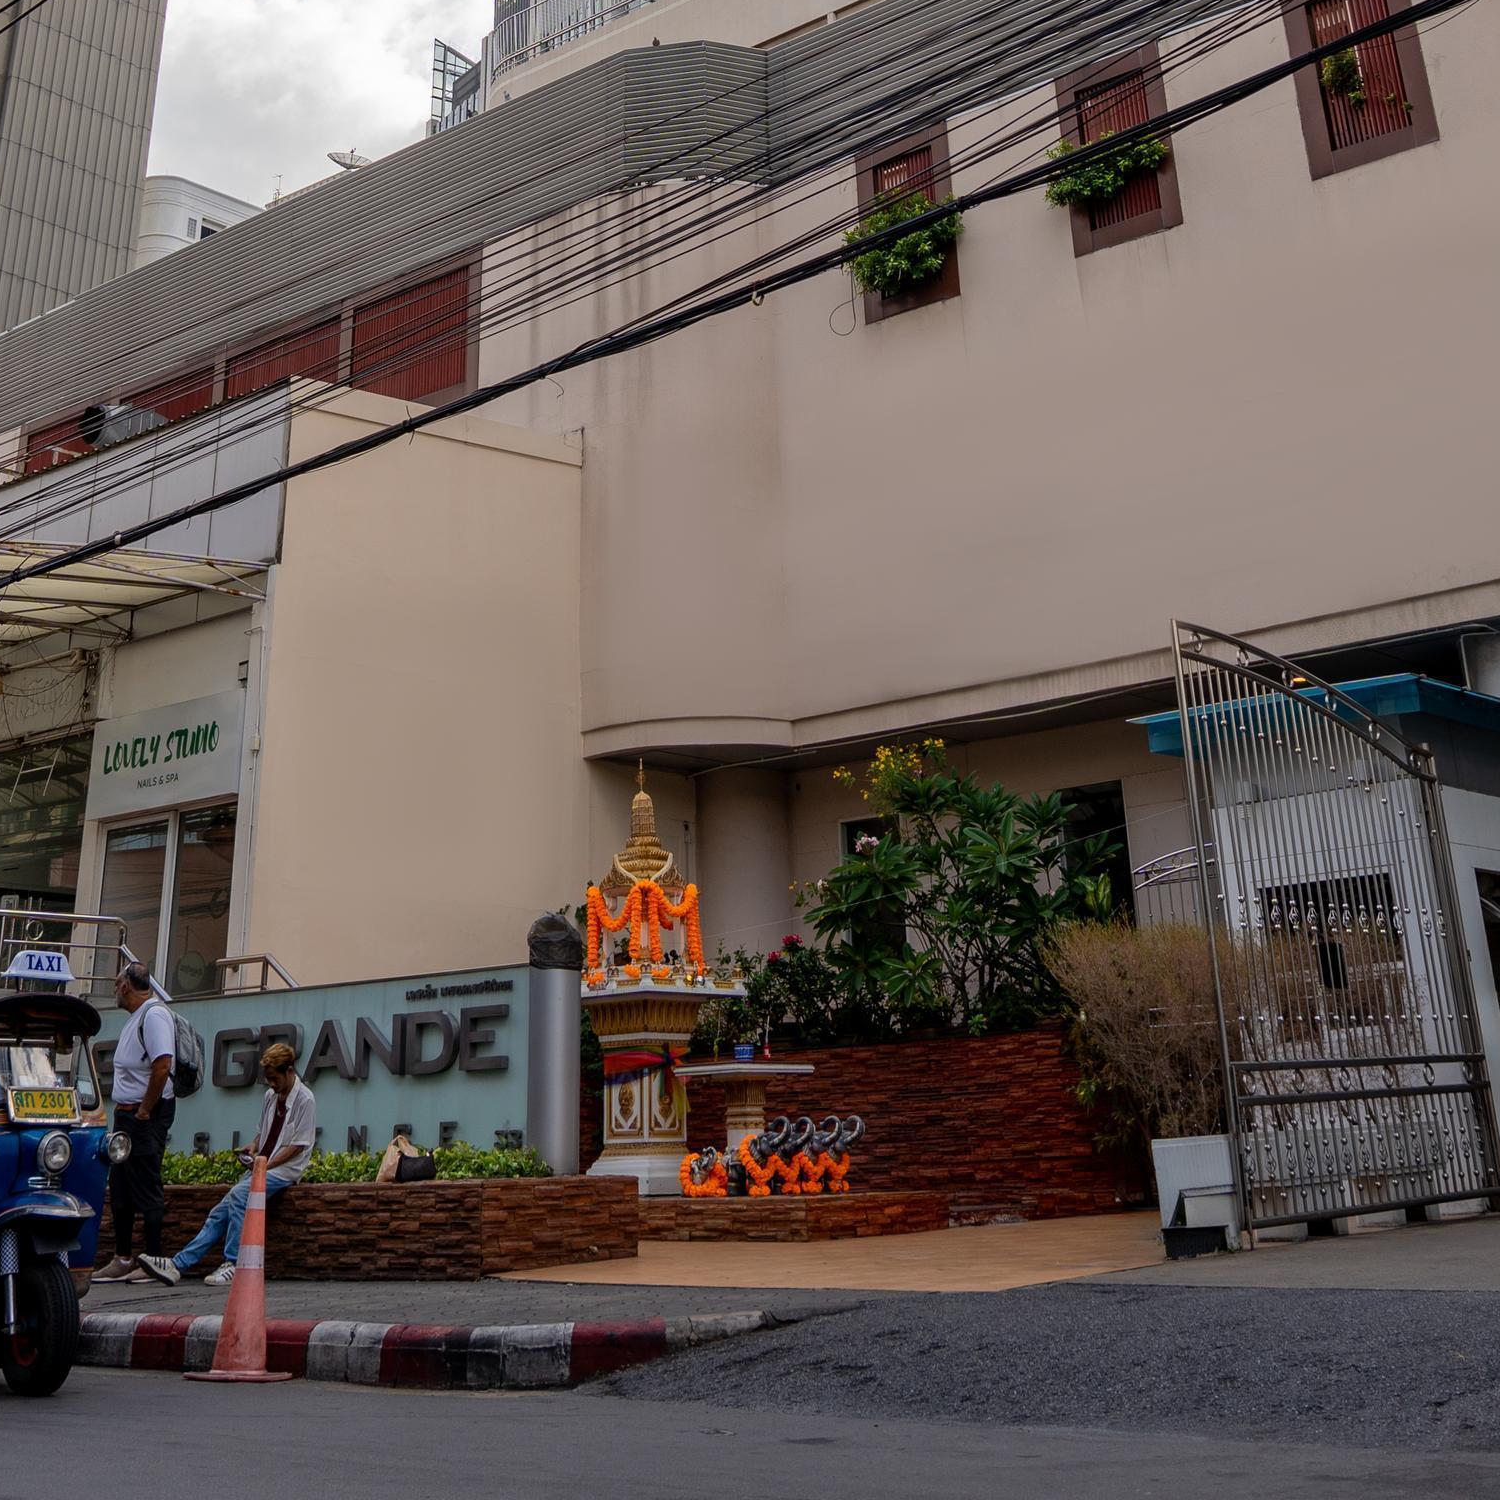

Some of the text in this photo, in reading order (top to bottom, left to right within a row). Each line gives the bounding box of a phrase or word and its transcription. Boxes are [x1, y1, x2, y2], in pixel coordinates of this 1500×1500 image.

[103, 720, 220, 775] LOVELY STUDIO
[137, 773, 179, 789] NAILS & SPA
[25, 954, 63, 972] TAXI
[212, 1004, 510, 1088] GRANDE
[39, 1094, 73, 1110] 2301
